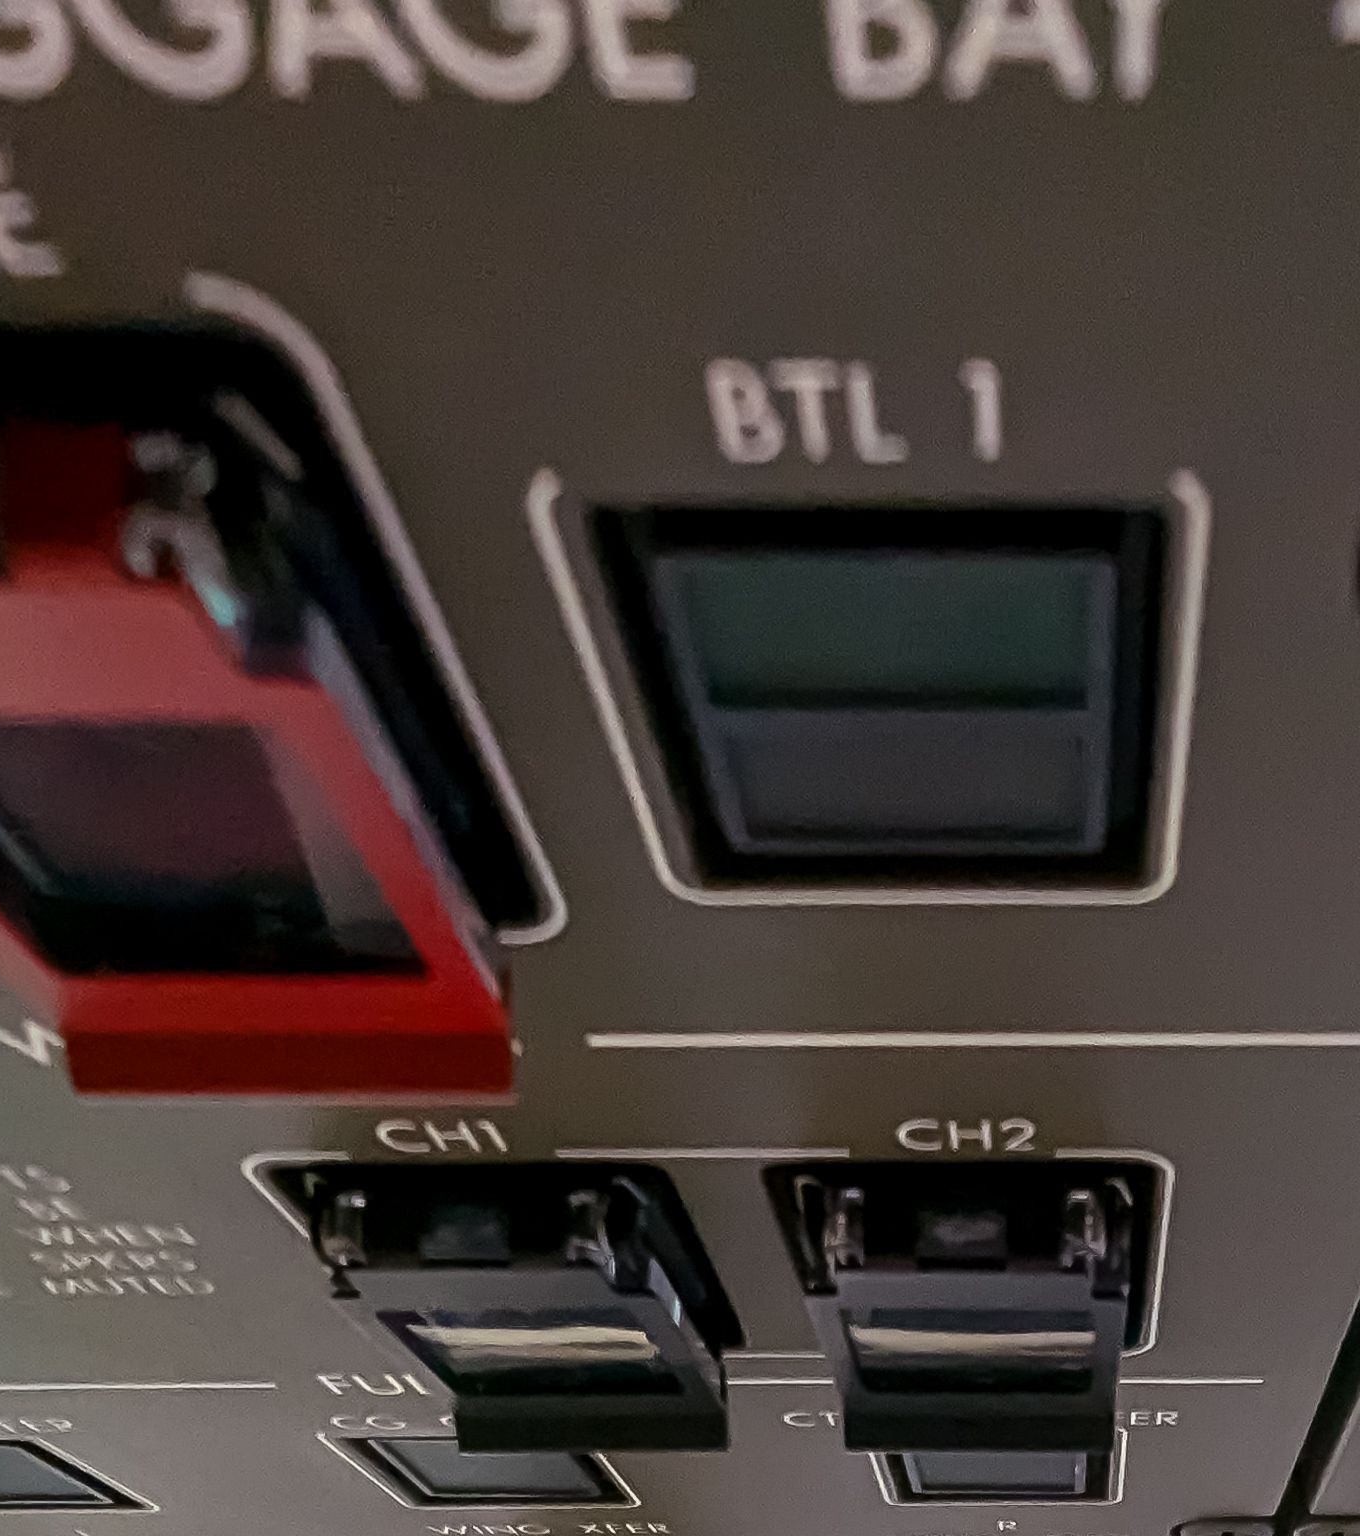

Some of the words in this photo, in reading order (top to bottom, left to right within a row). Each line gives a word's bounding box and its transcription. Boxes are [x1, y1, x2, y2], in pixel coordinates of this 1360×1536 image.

[704, 354, 909, 466] BTL
[958, 356, 1006, 464] 1
[374, 1118, 511, 1157] CH1
[895, 1116, 1042, 1154] CH2
[424, 1521, 552, 1536] WING
[577, 1520, 672, 1535] XFER
